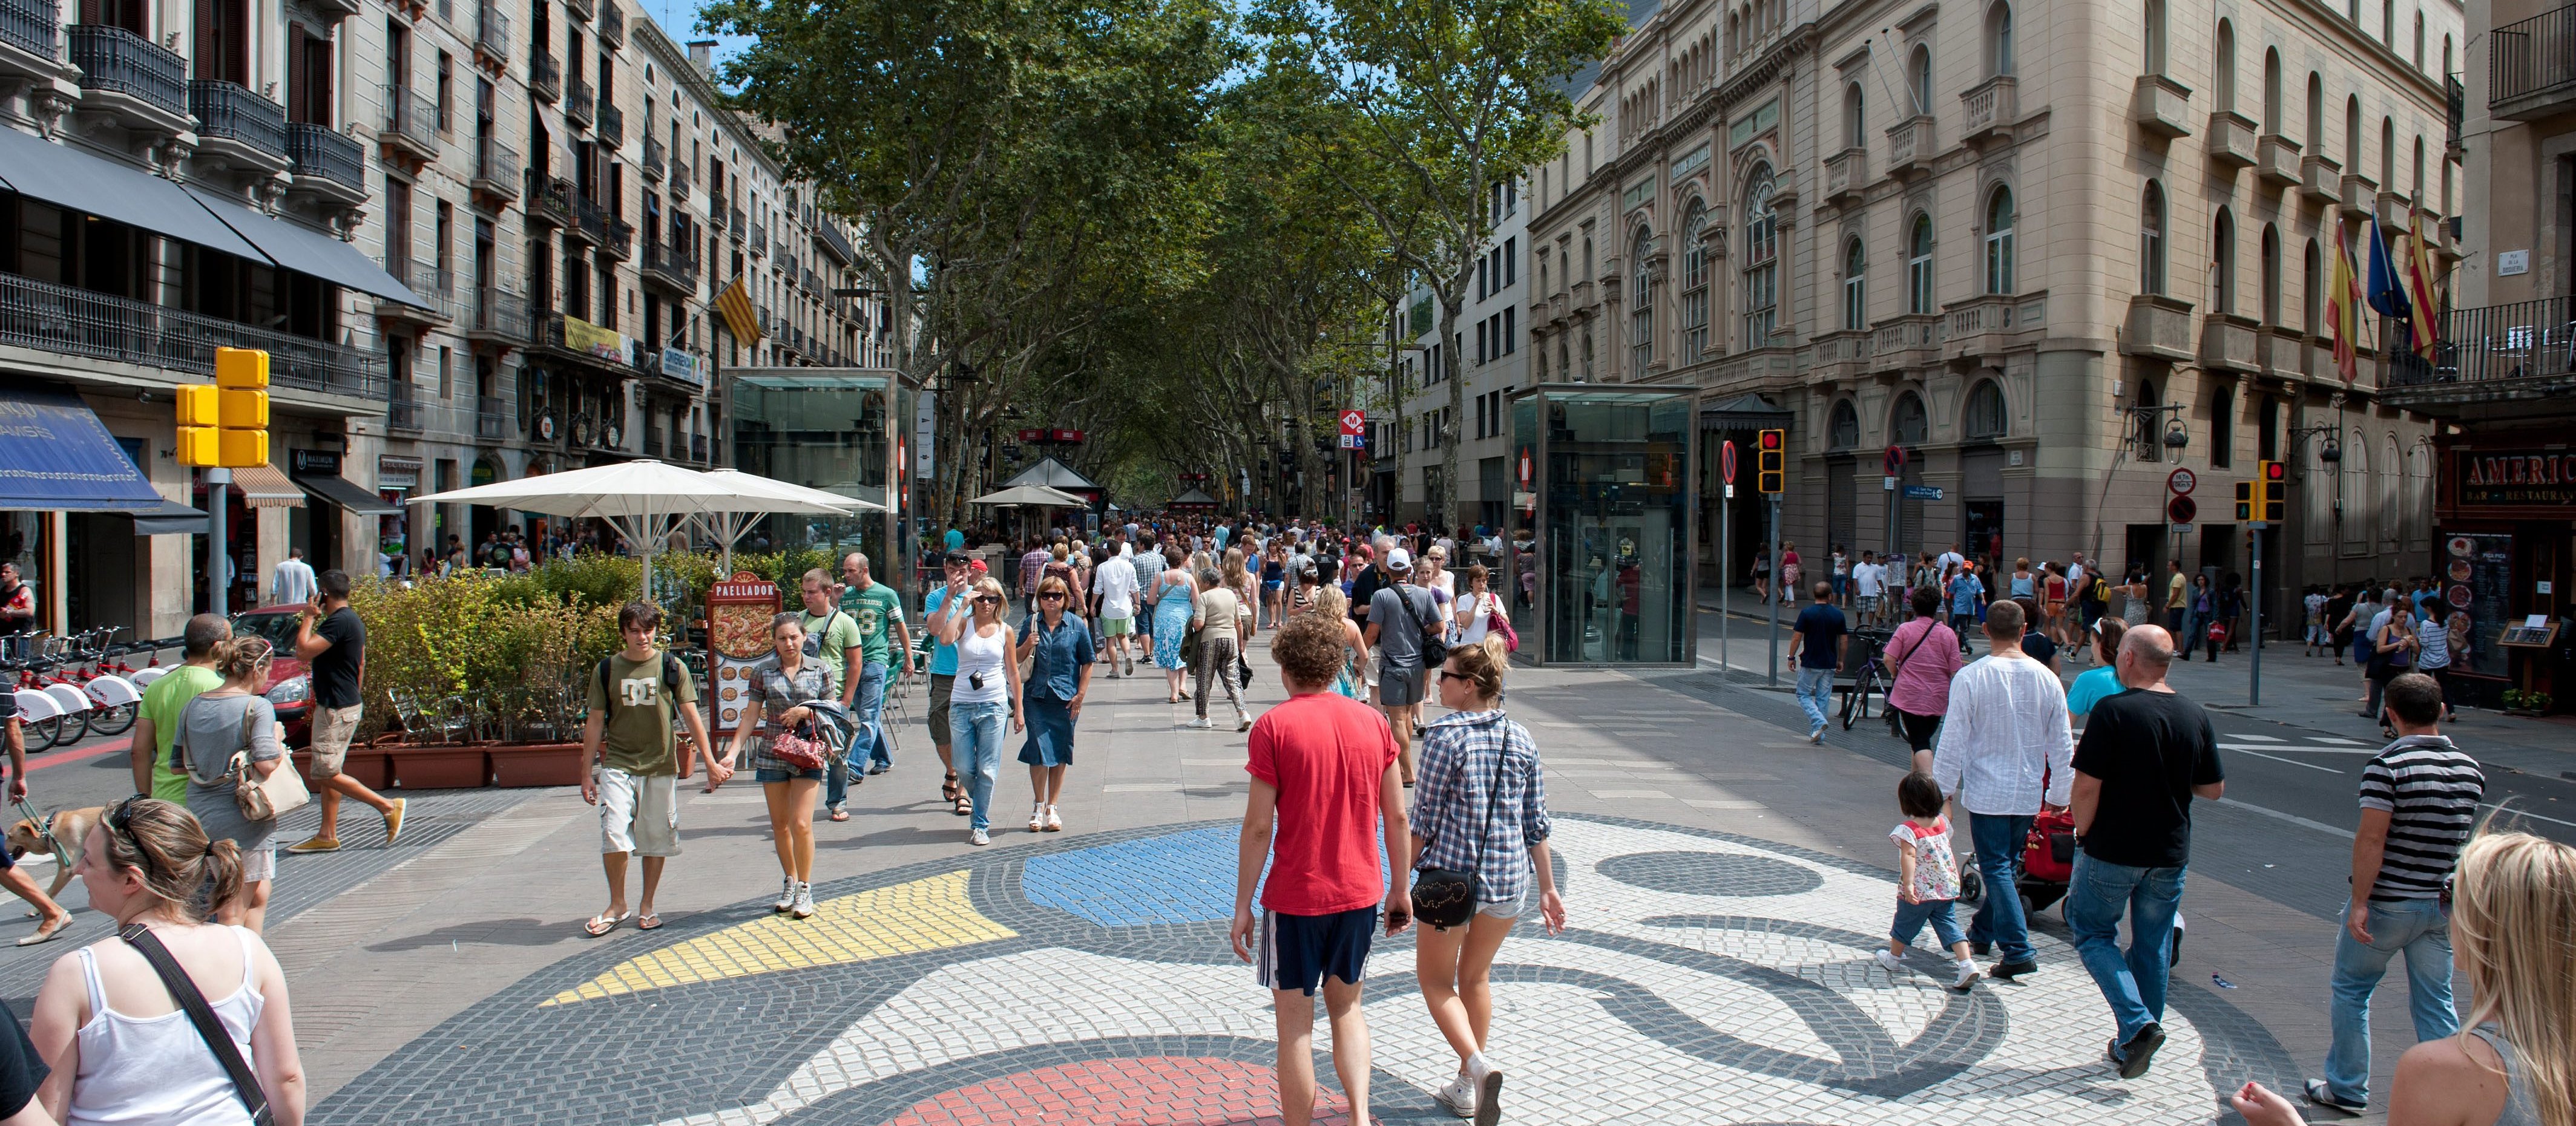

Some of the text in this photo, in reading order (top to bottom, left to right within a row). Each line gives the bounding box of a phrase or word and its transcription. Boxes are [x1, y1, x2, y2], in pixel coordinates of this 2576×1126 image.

[1349, 416, 1357, 425] M
[1522, 458, 1529, 480] M
[2466, 490, 2576, 500] BAR RESTAURAN
[716, 584, 774, 597] PAELLADOR
[856, 598, 883, 607] STRAUSS
